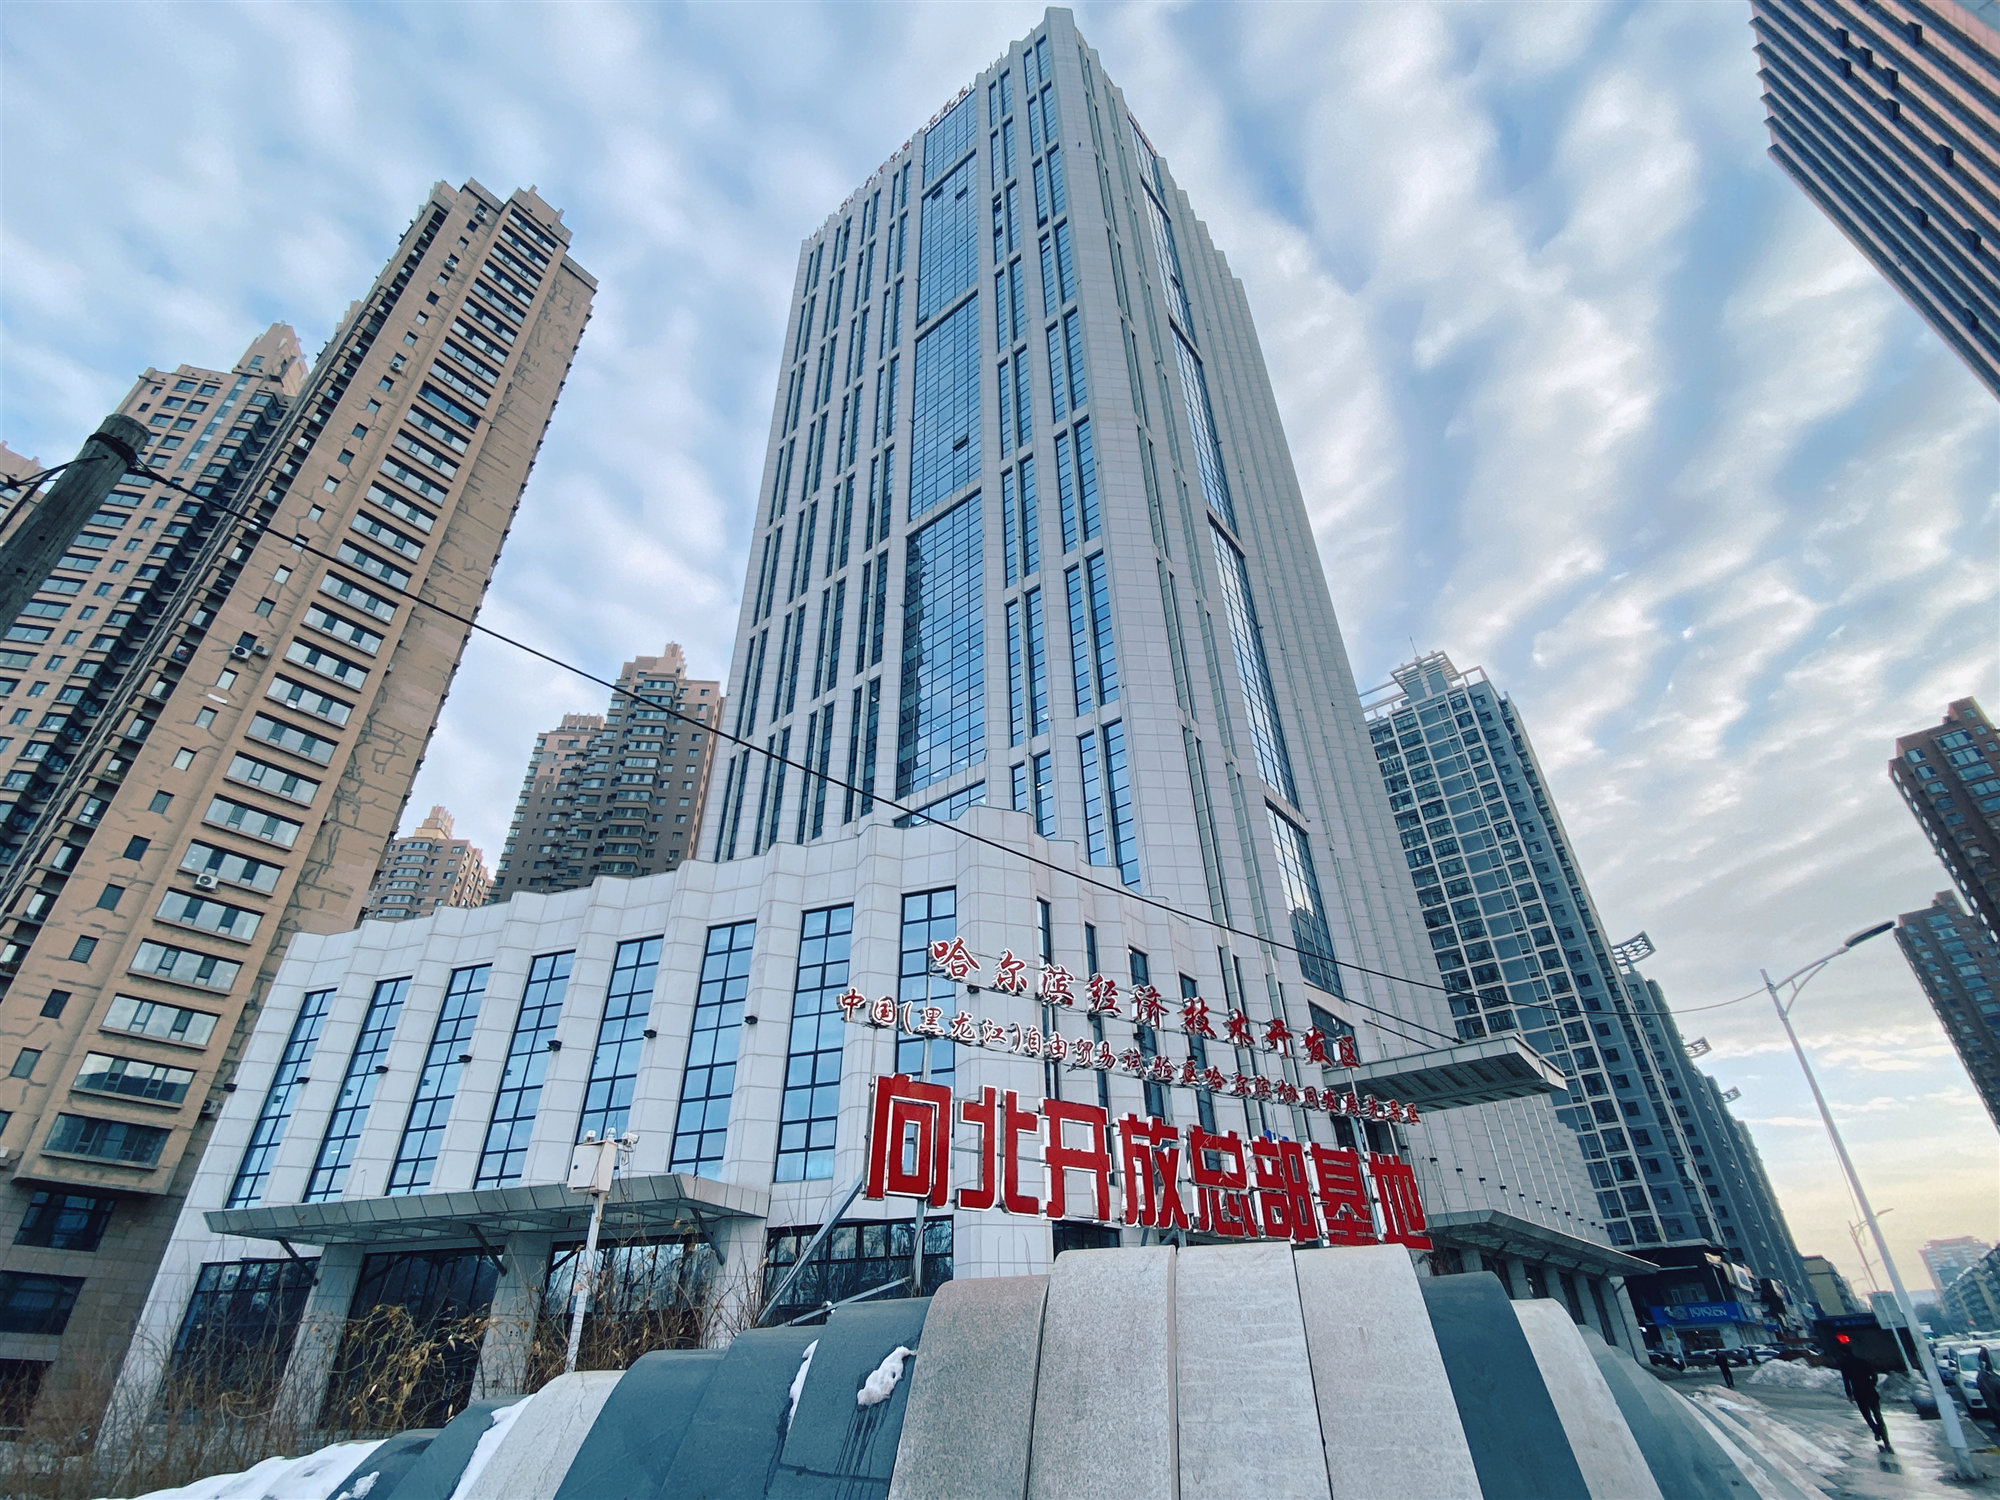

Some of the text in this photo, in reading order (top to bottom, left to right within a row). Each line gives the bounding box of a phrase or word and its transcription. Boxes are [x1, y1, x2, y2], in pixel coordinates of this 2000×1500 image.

[930, 936, 1360, 1068] 哈尔滨经济技术开发区
[864, 1073, 1433, 1251] 向北开放总部基地
